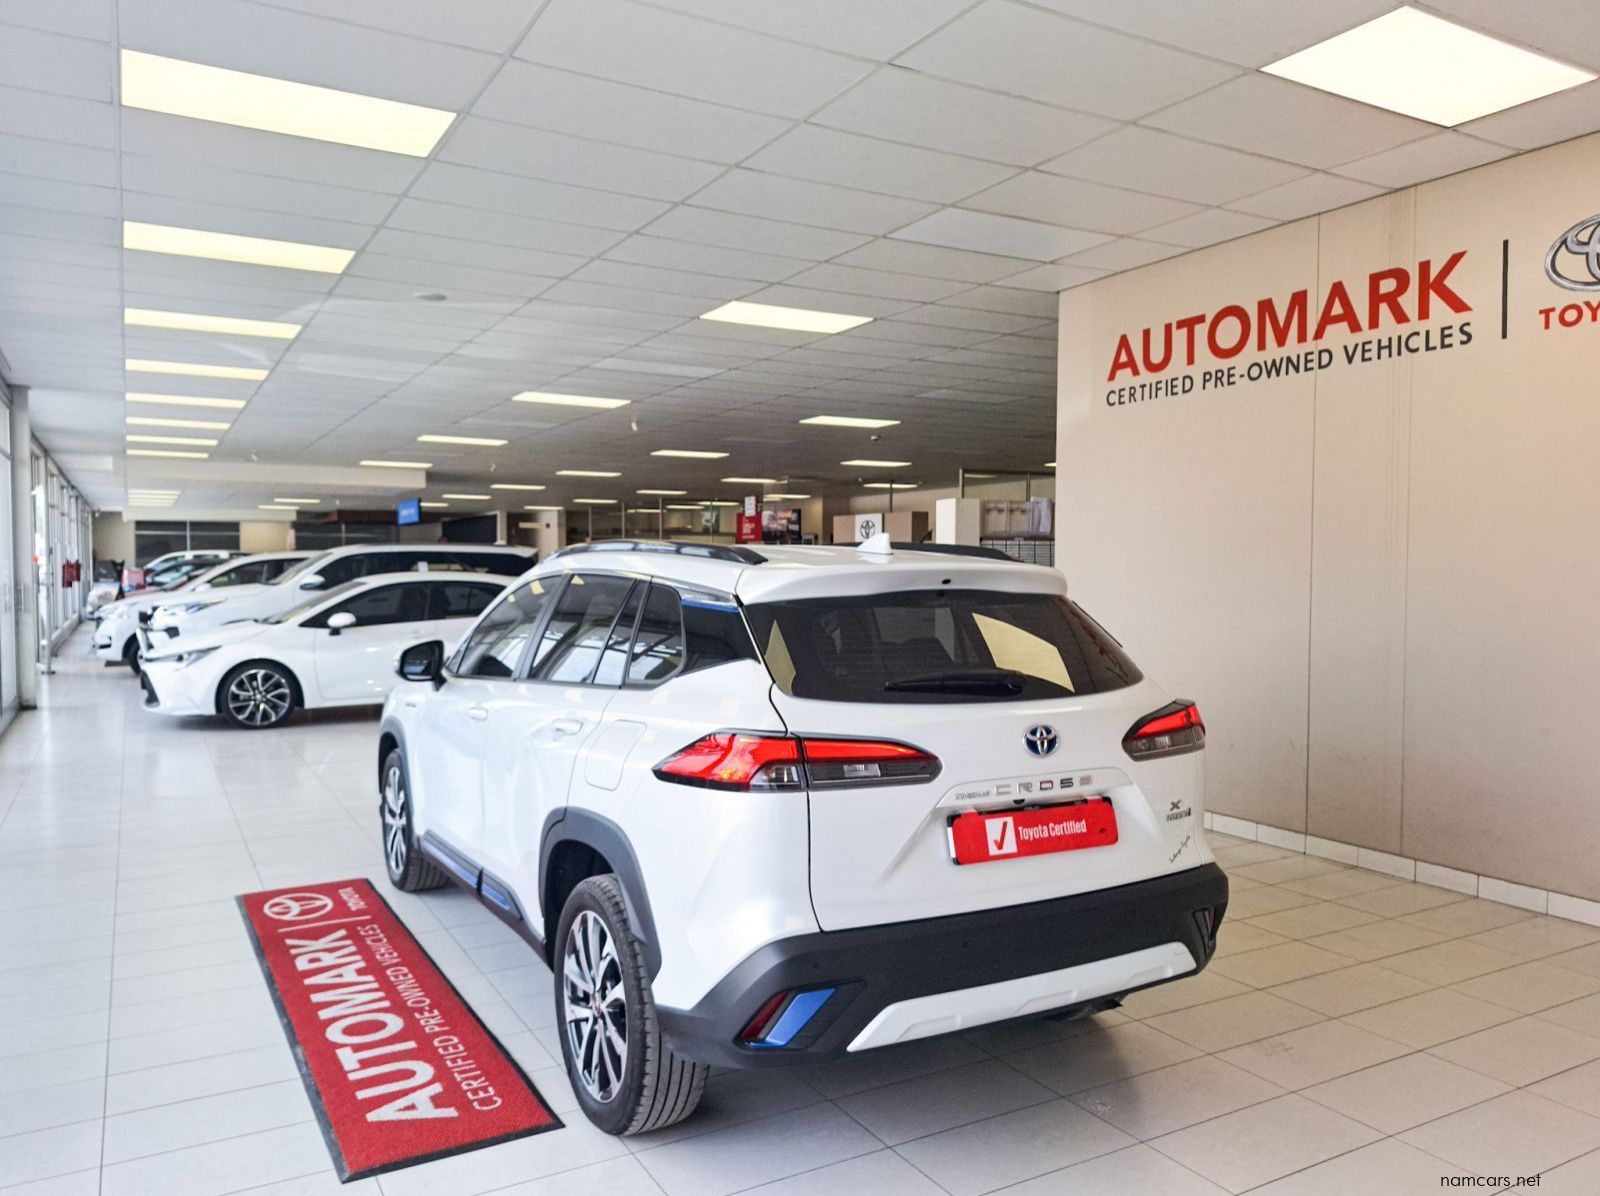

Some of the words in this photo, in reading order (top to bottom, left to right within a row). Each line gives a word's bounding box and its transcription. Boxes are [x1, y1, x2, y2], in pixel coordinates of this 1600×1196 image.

[1107, 250, 1473, 382] AUTOMARK
[1106, 375, 1194, 407] CERTIFIED
[1202, 348, 1333, 391] PRE-OWNED
[1343, 321, 1473, 365] VEHICLES
[1018, 824, 1049, 841] Toyota
[1049, 819, 1087, 837] Certified
[357, 924, 402, 966] VEHICLES
[284, 929, 459, 1122] AUTOMARK
[386, 966, 450, 1034] PRE-OWNED
[433, 1035, 501, 1111] CERTIFIED
